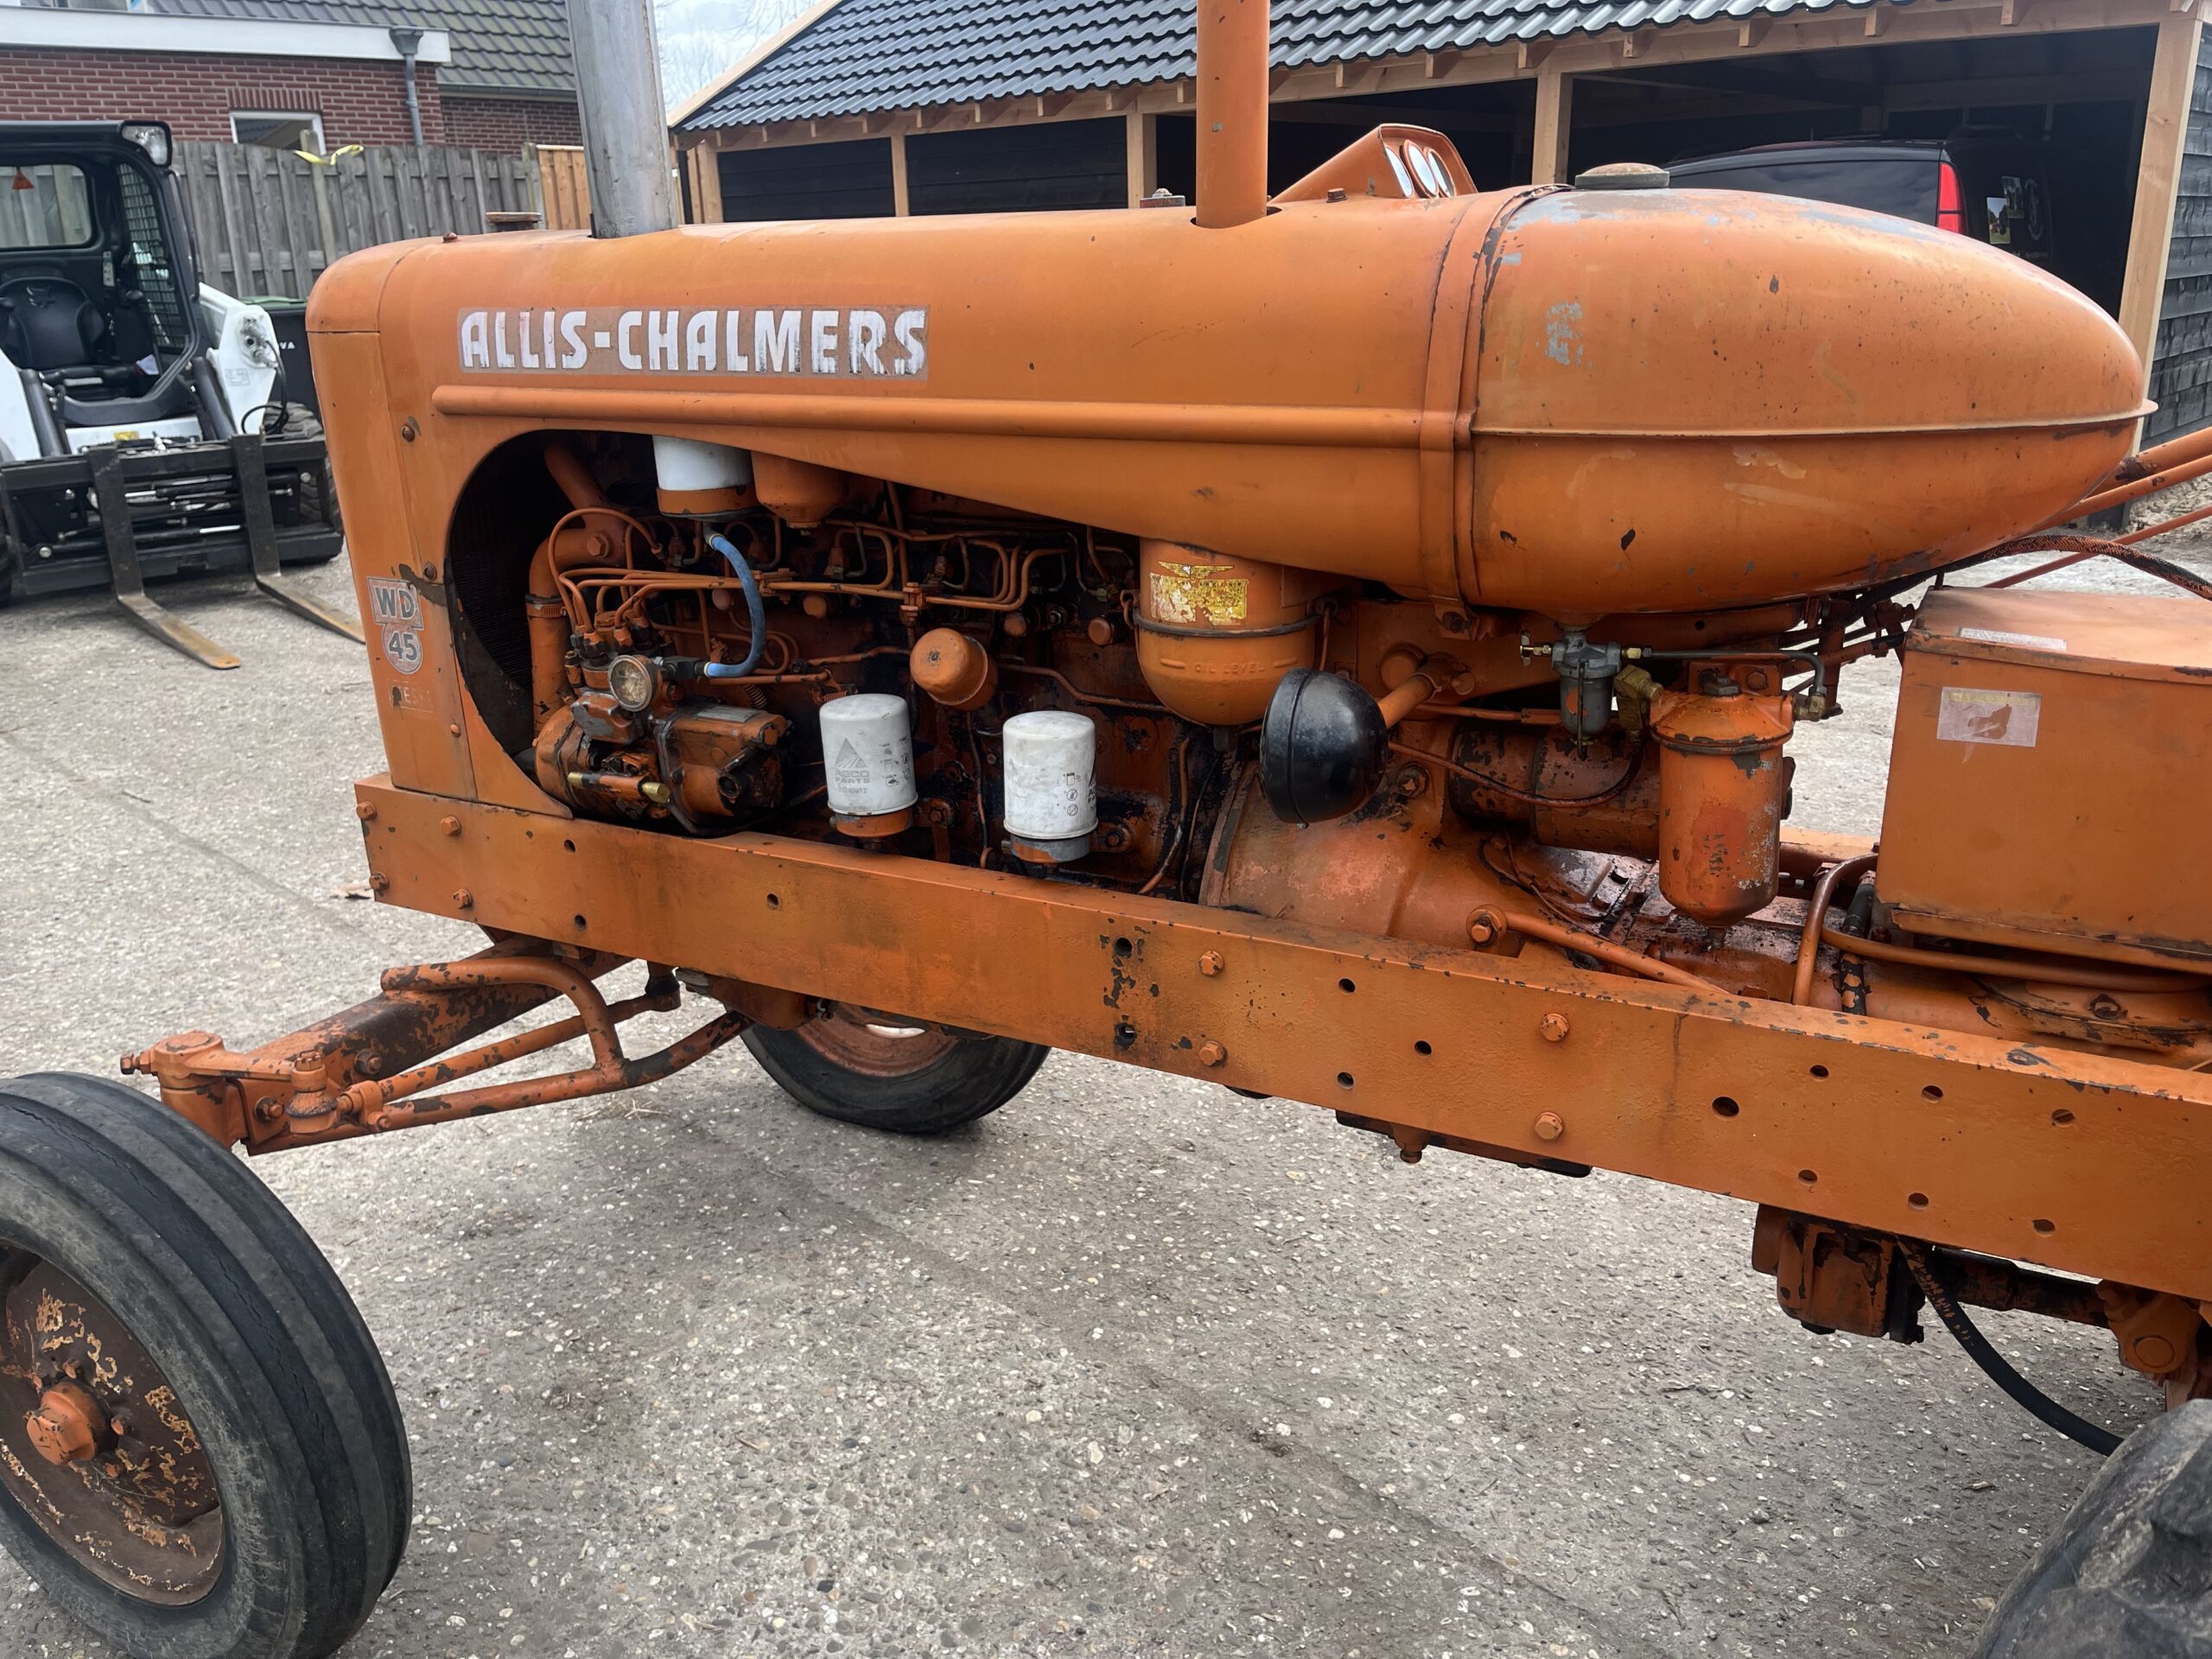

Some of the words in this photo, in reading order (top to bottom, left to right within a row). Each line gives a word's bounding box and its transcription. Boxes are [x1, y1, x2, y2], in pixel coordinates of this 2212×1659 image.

[461, 309, 925, 375] ALLIS-CHALMERS
[375, 587, 415, 619] WD
[389, 632, 417, 661] 45
